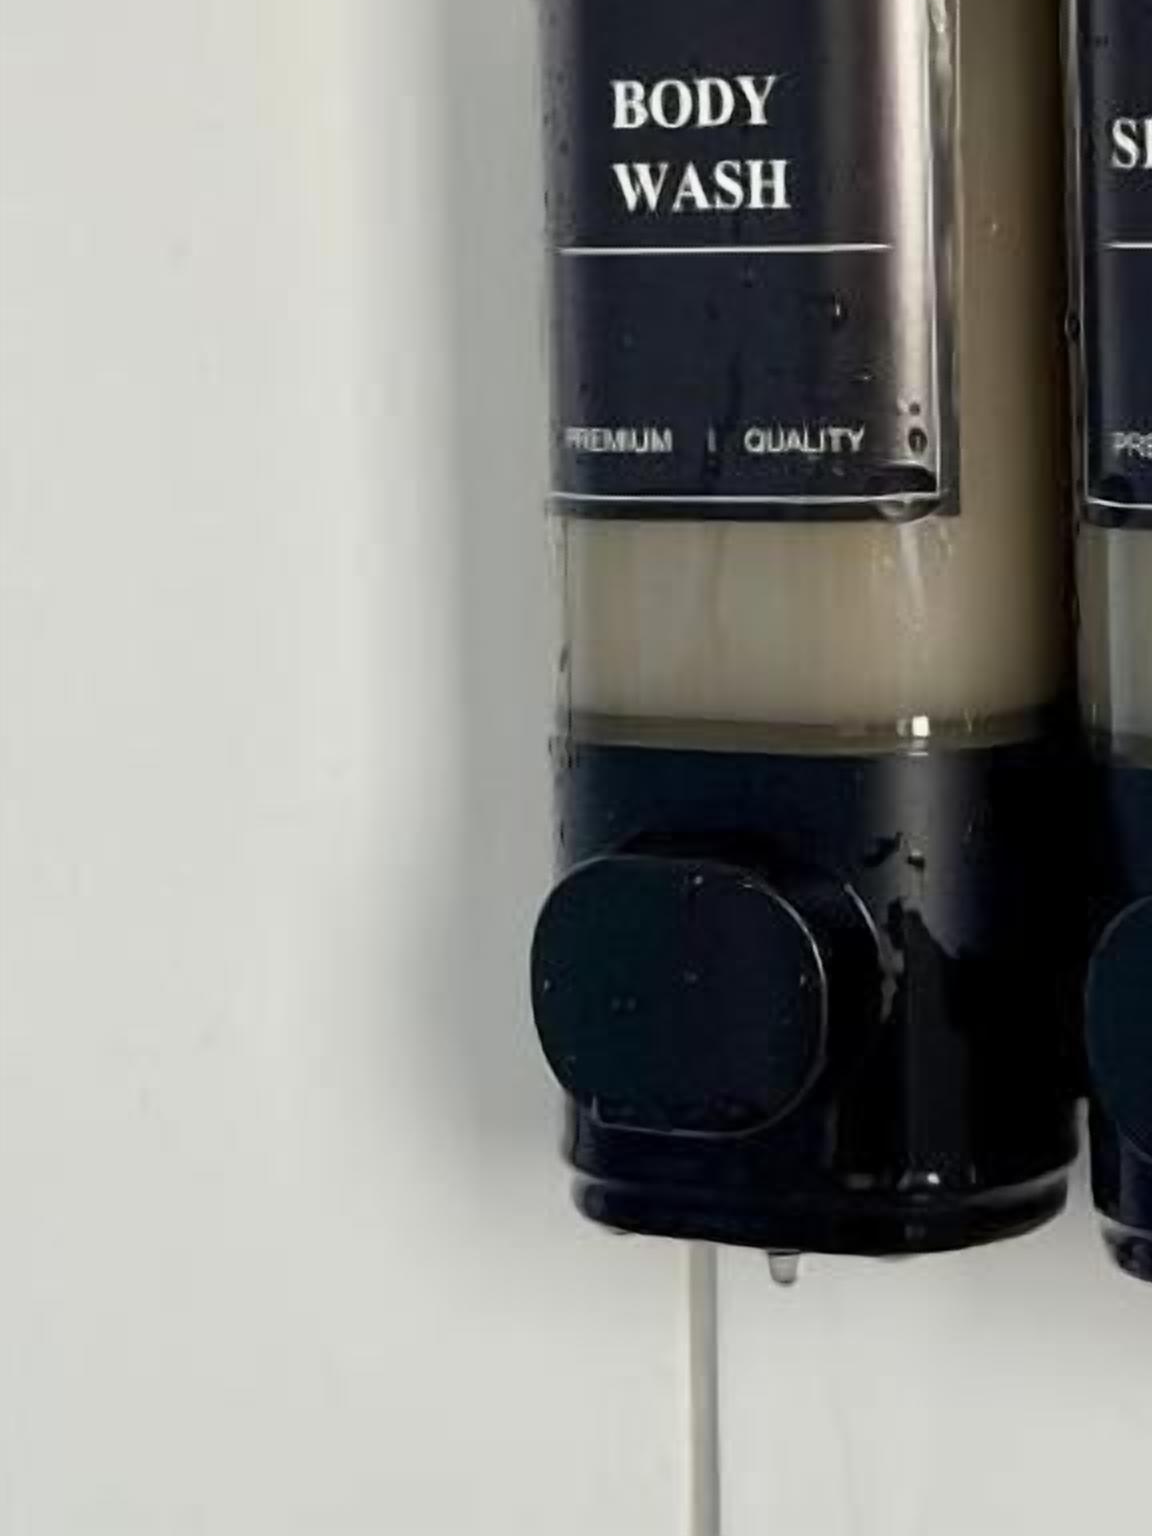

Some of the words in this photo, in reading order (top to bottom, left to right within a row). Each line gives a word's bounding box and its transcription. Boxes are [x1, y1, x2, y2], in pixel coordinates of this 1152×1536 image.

[611, 75, 777, 129] BODY
[612, 160, 791, 212] WASH
[744, 426, 865, 452] QUALITY
